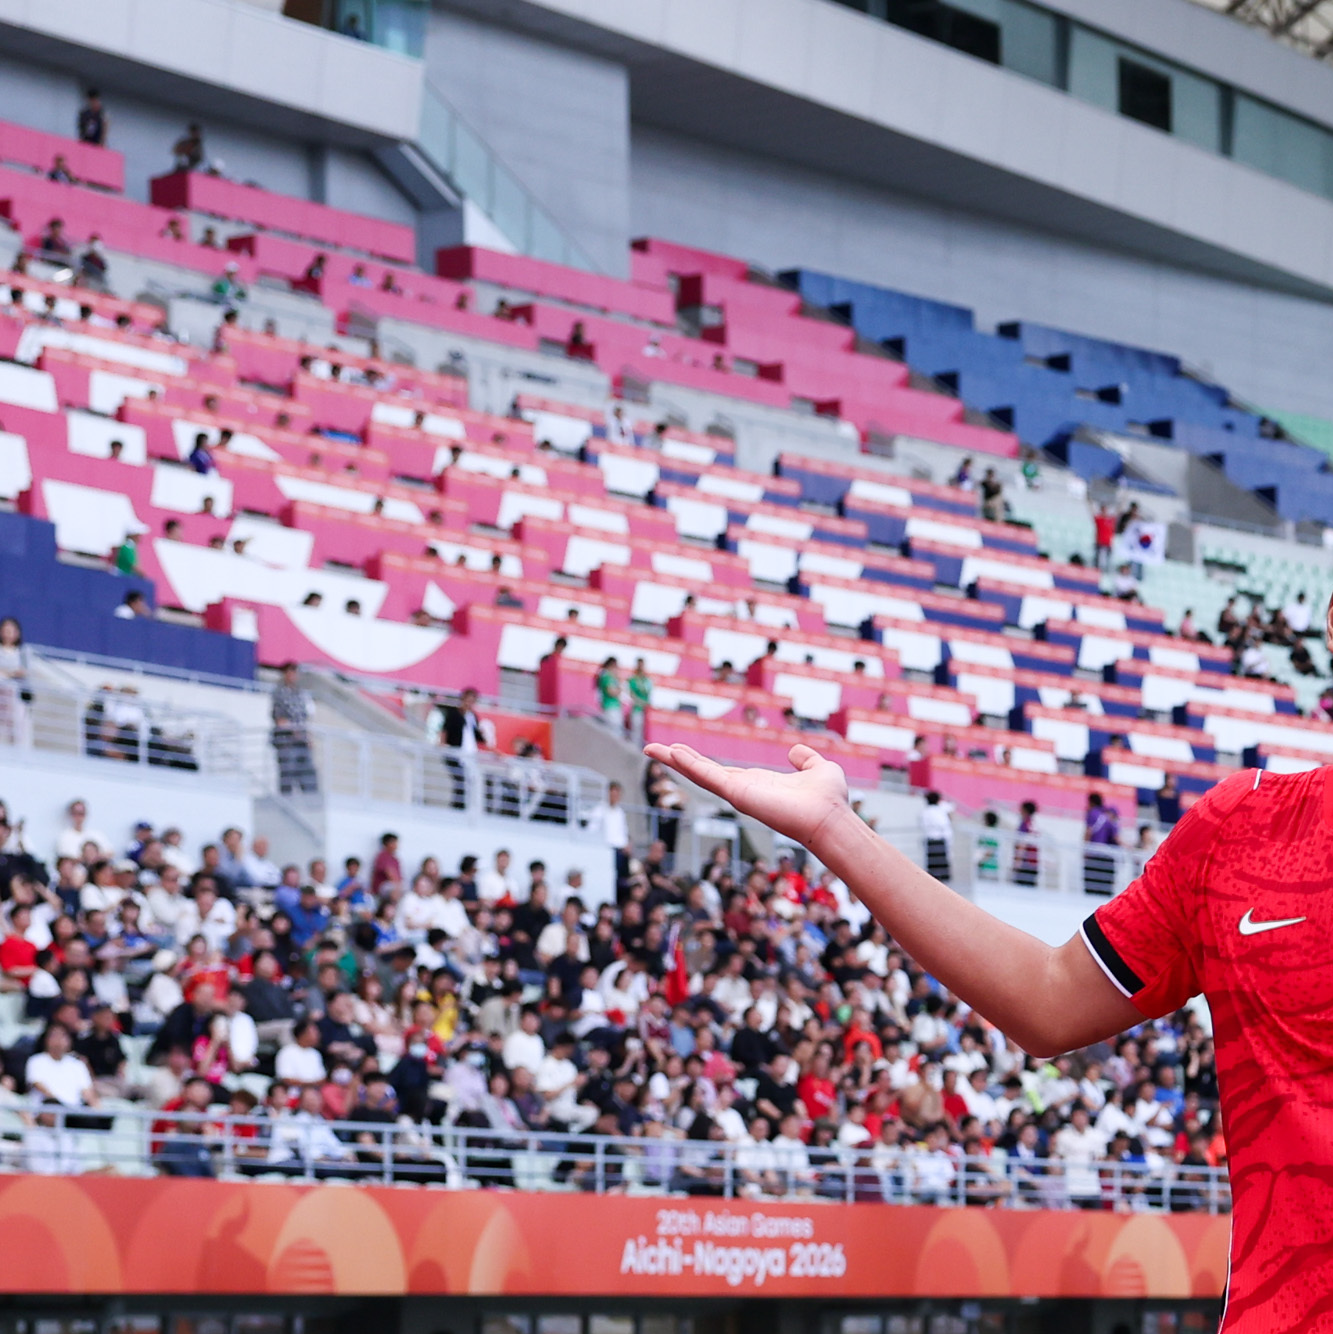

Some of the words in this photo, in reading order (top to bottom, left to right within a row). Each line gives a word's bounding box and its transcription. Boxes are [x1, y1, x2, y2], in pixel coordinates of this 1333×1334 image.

[703, 1209, 749, 1237] Asian
[751, 1212, 814, 1239] Games
[620, 1235, 787, 1286] Aichi-Nagoya
[789, 1242, 847, 1277] 2026
